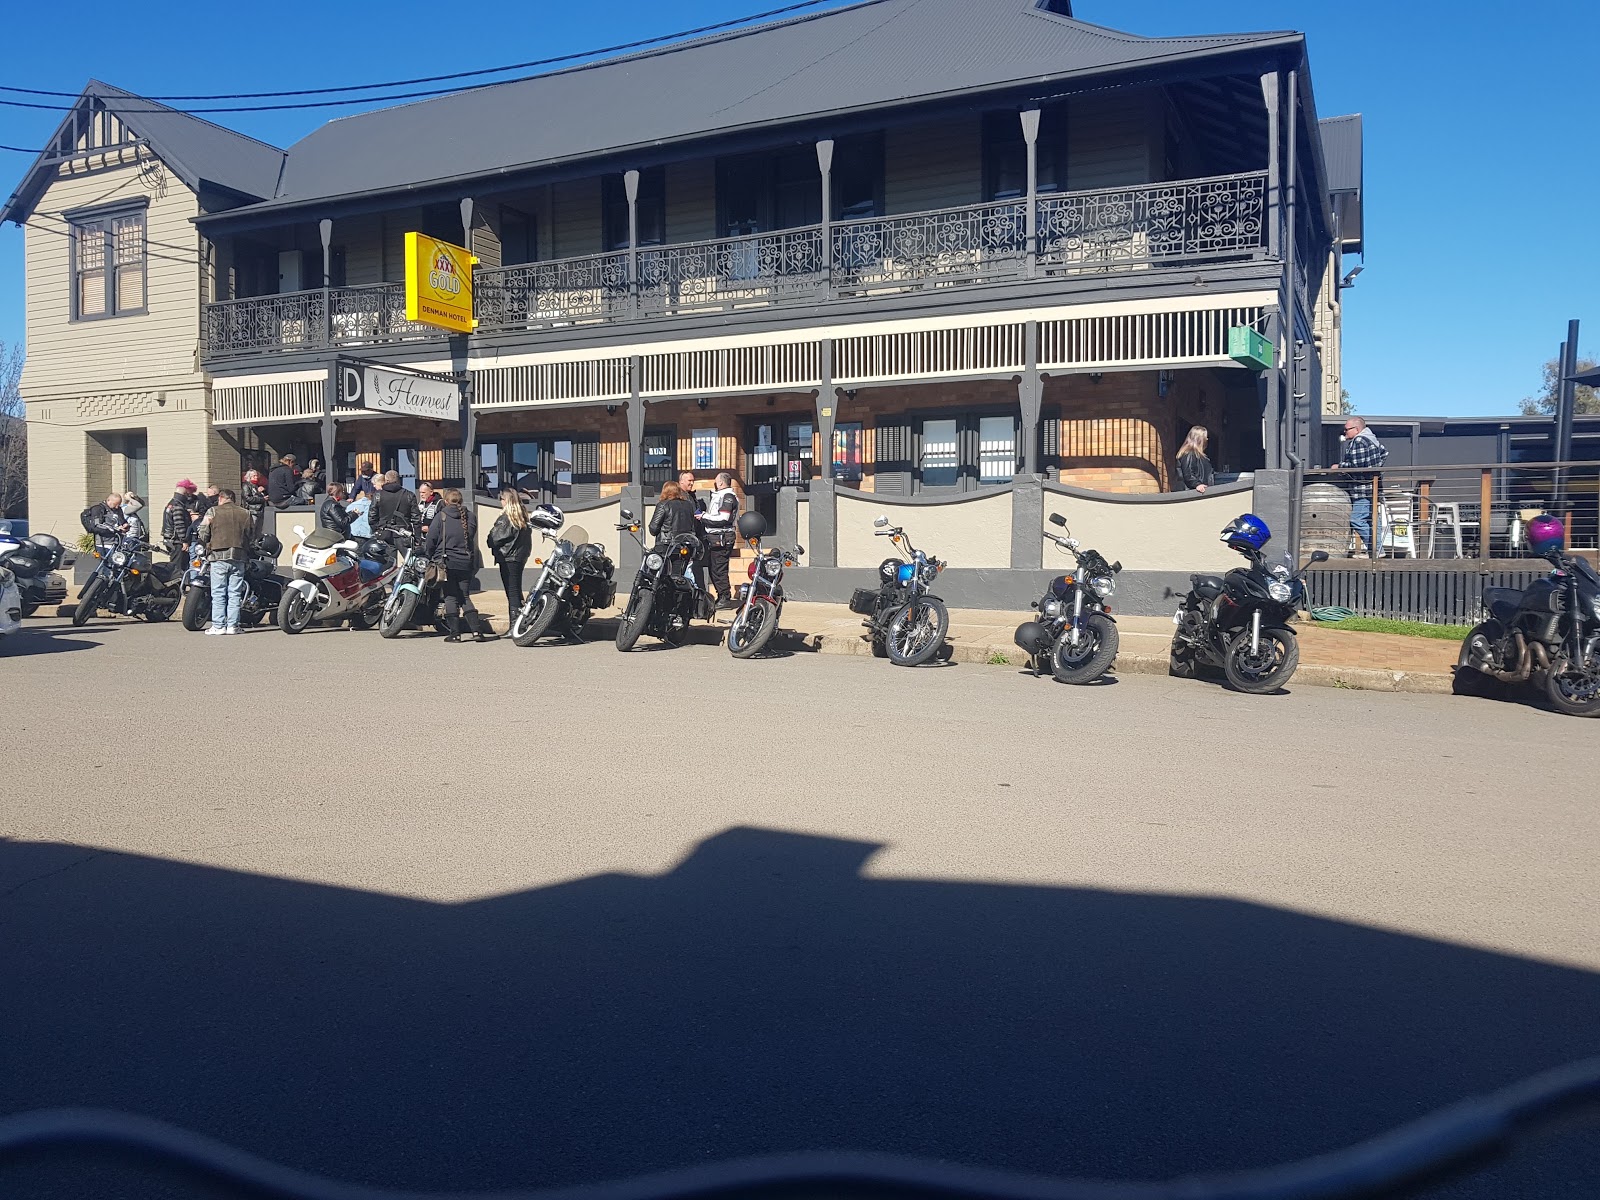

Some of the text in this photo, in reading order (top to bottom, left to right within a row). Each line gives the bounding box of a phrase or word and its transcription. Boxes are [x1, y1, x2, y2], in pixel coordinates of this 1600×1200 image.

[434, 259, 456, 275] XXXX
[429, 270, 460, 294] GOLD
[422, 305, 467, 323] DENMAN HOTEL
[343, 366, 362, 402] D
[380, 377, 453, 411] Harvest
